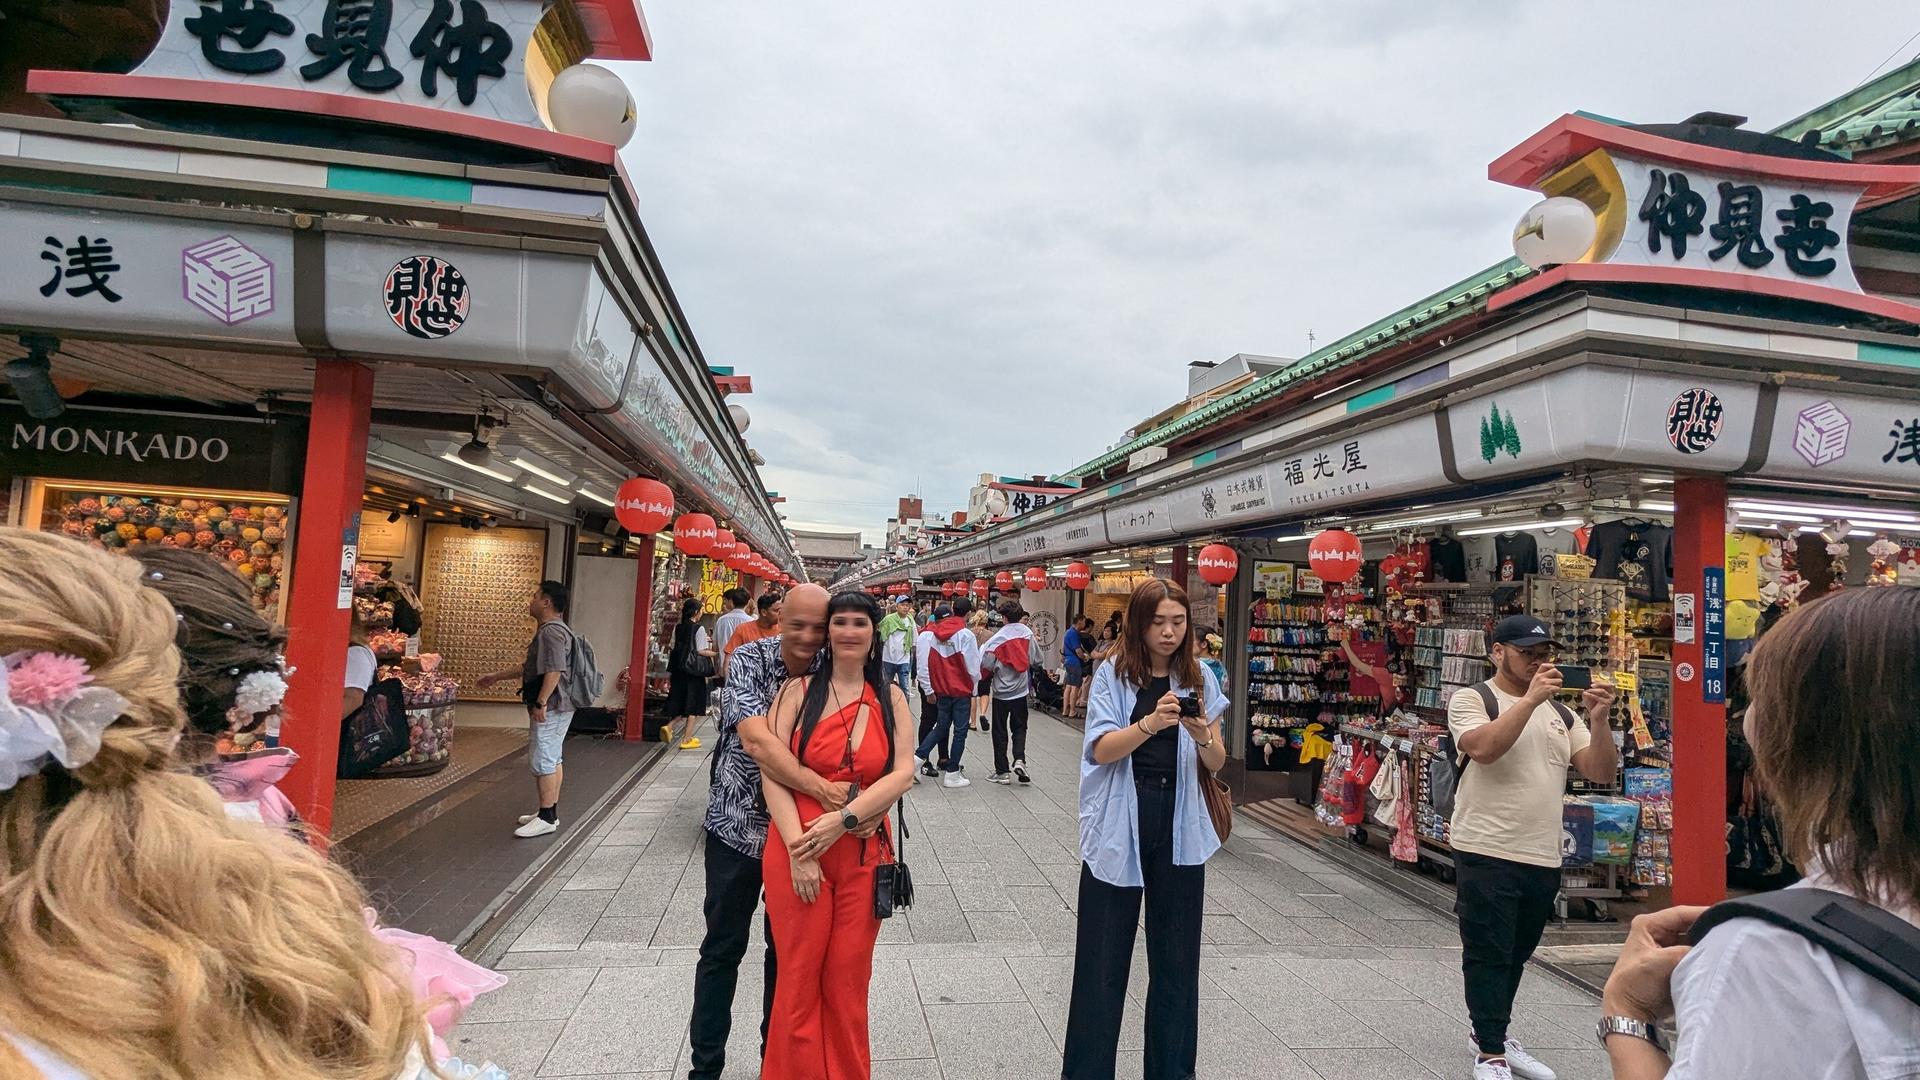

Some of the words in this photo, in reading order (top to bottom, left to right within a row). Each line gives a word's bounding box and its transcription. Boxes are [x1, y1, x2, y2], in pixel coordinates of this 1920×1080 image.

[1639, 168, 1840, 277] 仲見世
[39, 235, 123, 303] 浅
[12, 423, 229, 462] MONKADO
[1284, 441, 1368, 487] 福光屋
[1709, 597, 1720, 669] 浅草一丁目
[1706, 679, 1721, 694] 18
